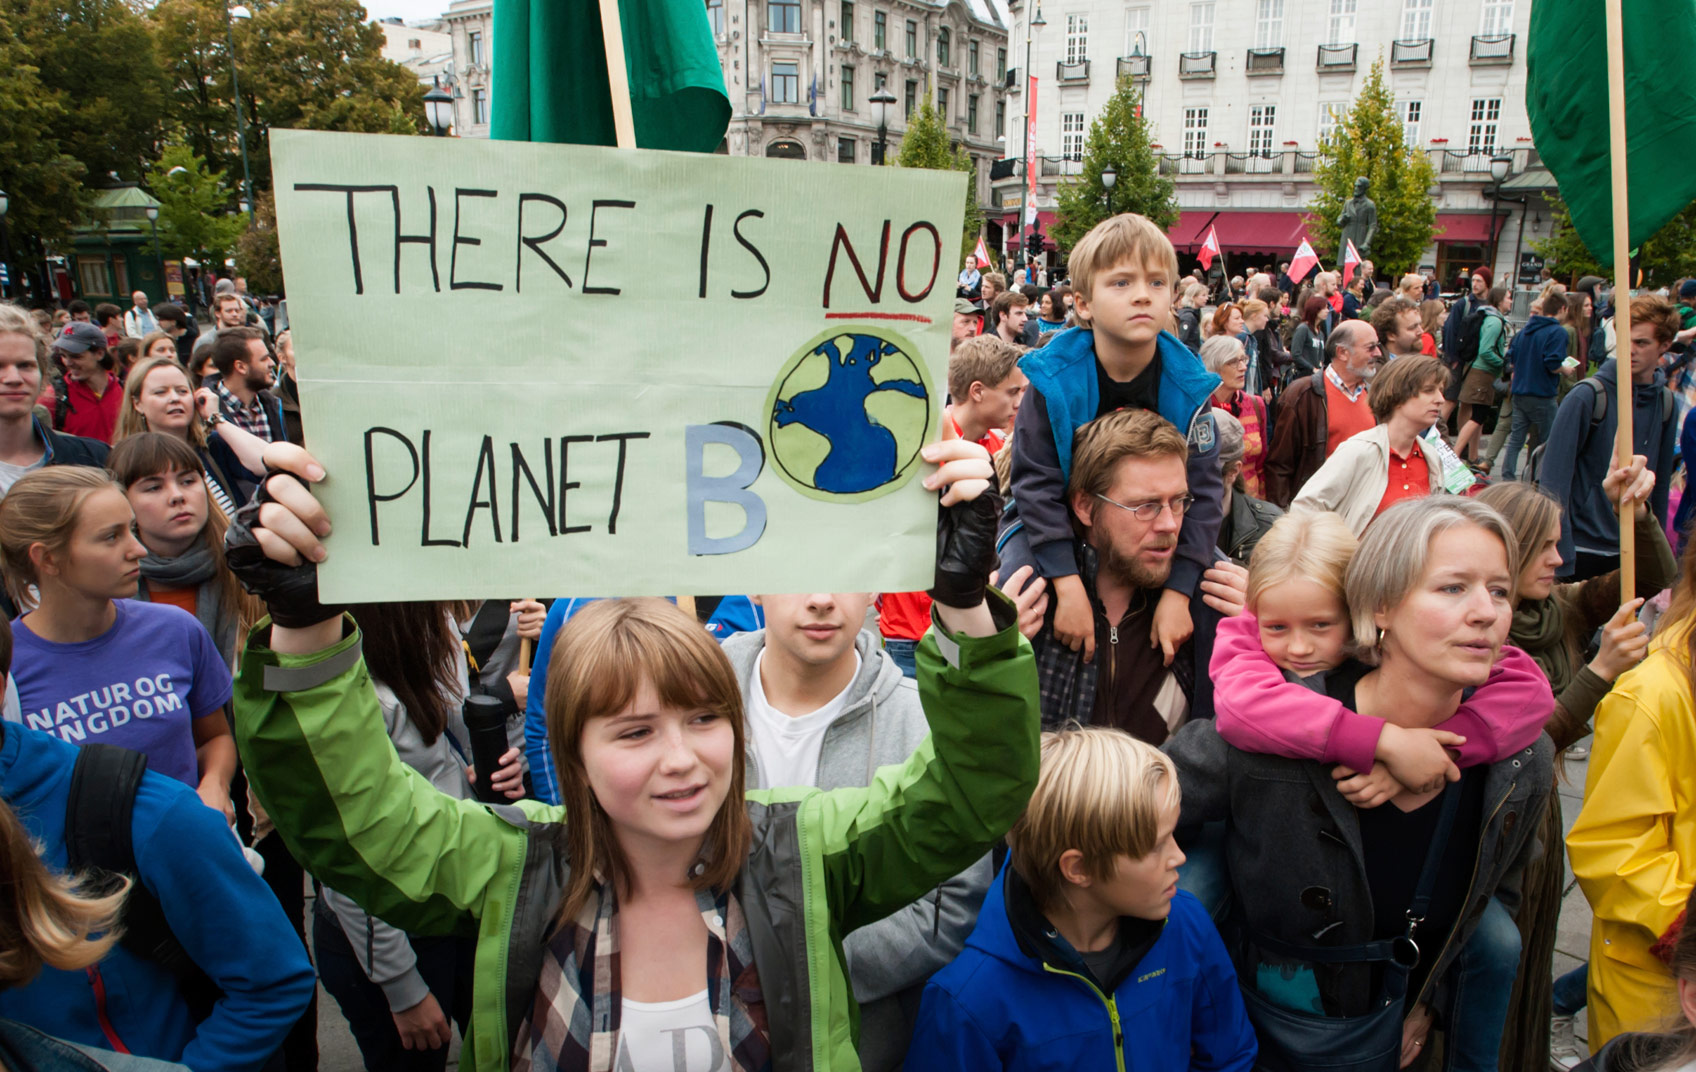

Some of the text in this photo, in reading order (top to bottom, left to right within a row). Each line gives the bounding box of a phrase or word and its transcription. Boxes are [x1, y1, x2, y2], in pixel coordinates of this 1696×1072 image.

[732, 14, 740, 85] HOTEL
[828, 19, 836, 89] HOTEL
[294, 184, 635, 295] THERE
[699, 204, 771, 298] IS
[823, 220, 942, 307] NO
[365, 421, 767, 556] PLANET B
[26, 673, 174, 730] NATUR OG
[47, 692, 183, 744] NGDOM
